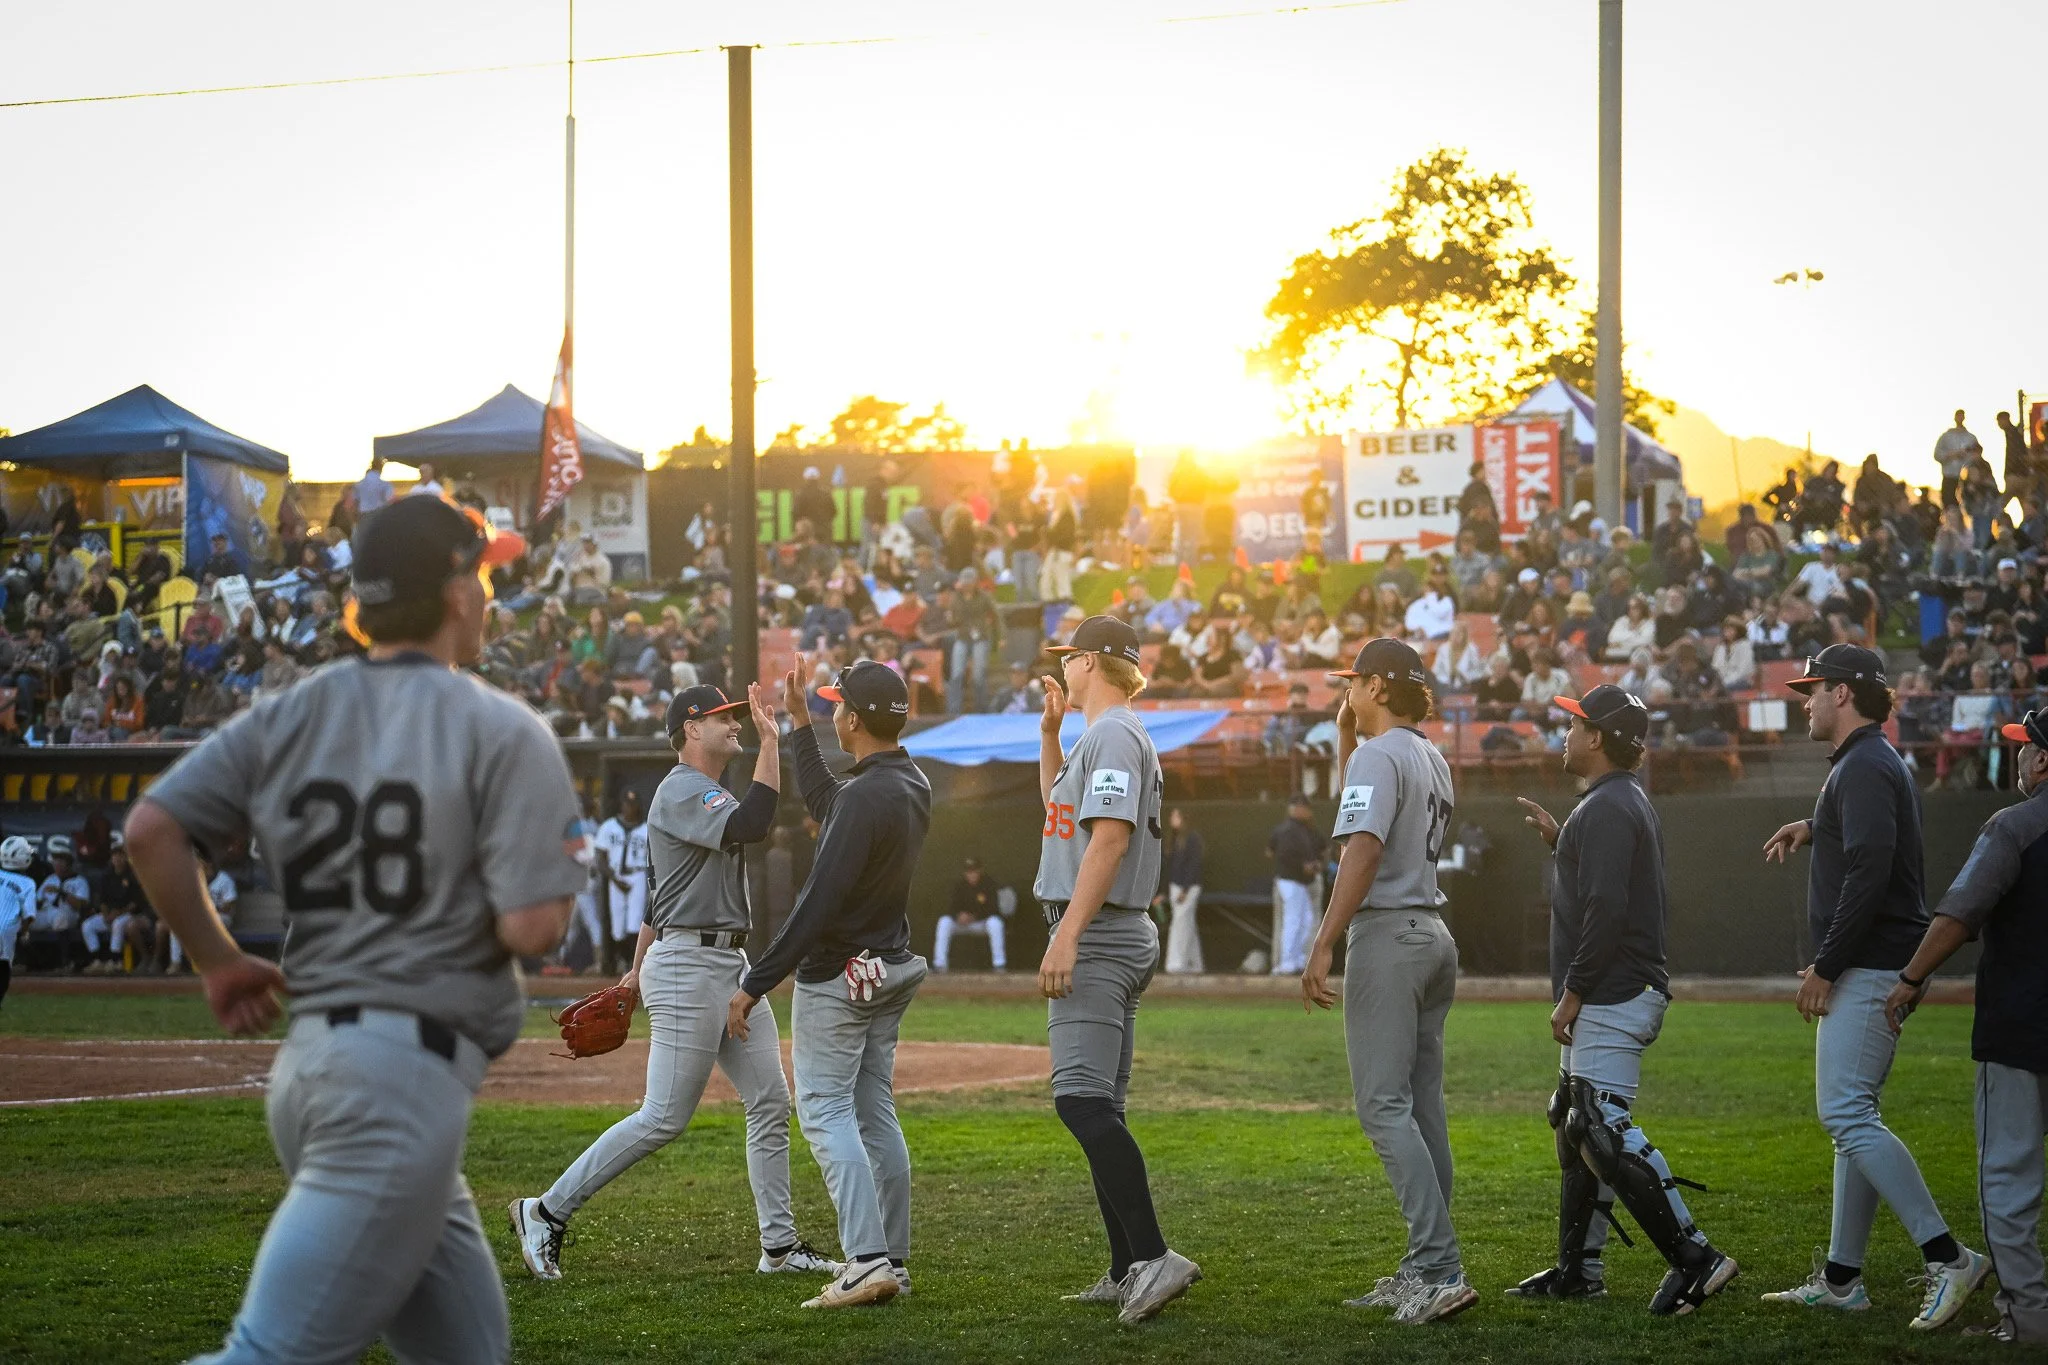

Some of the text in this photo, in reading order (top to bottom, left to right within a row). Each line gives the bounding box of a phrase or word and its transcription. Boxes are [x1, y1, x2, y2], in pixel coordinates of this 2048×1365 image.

[1360, 432, 1458, 457] BEER
[1395, 465, 1421, 486] &
[1515, 424, 1551, 521] EXIT
[130, 485, 184, 520] VIP
[1043, 801, 1076, 840] 35
[1425, 791, 1454, 867] 27
[284, 780, 425, 917] 28
